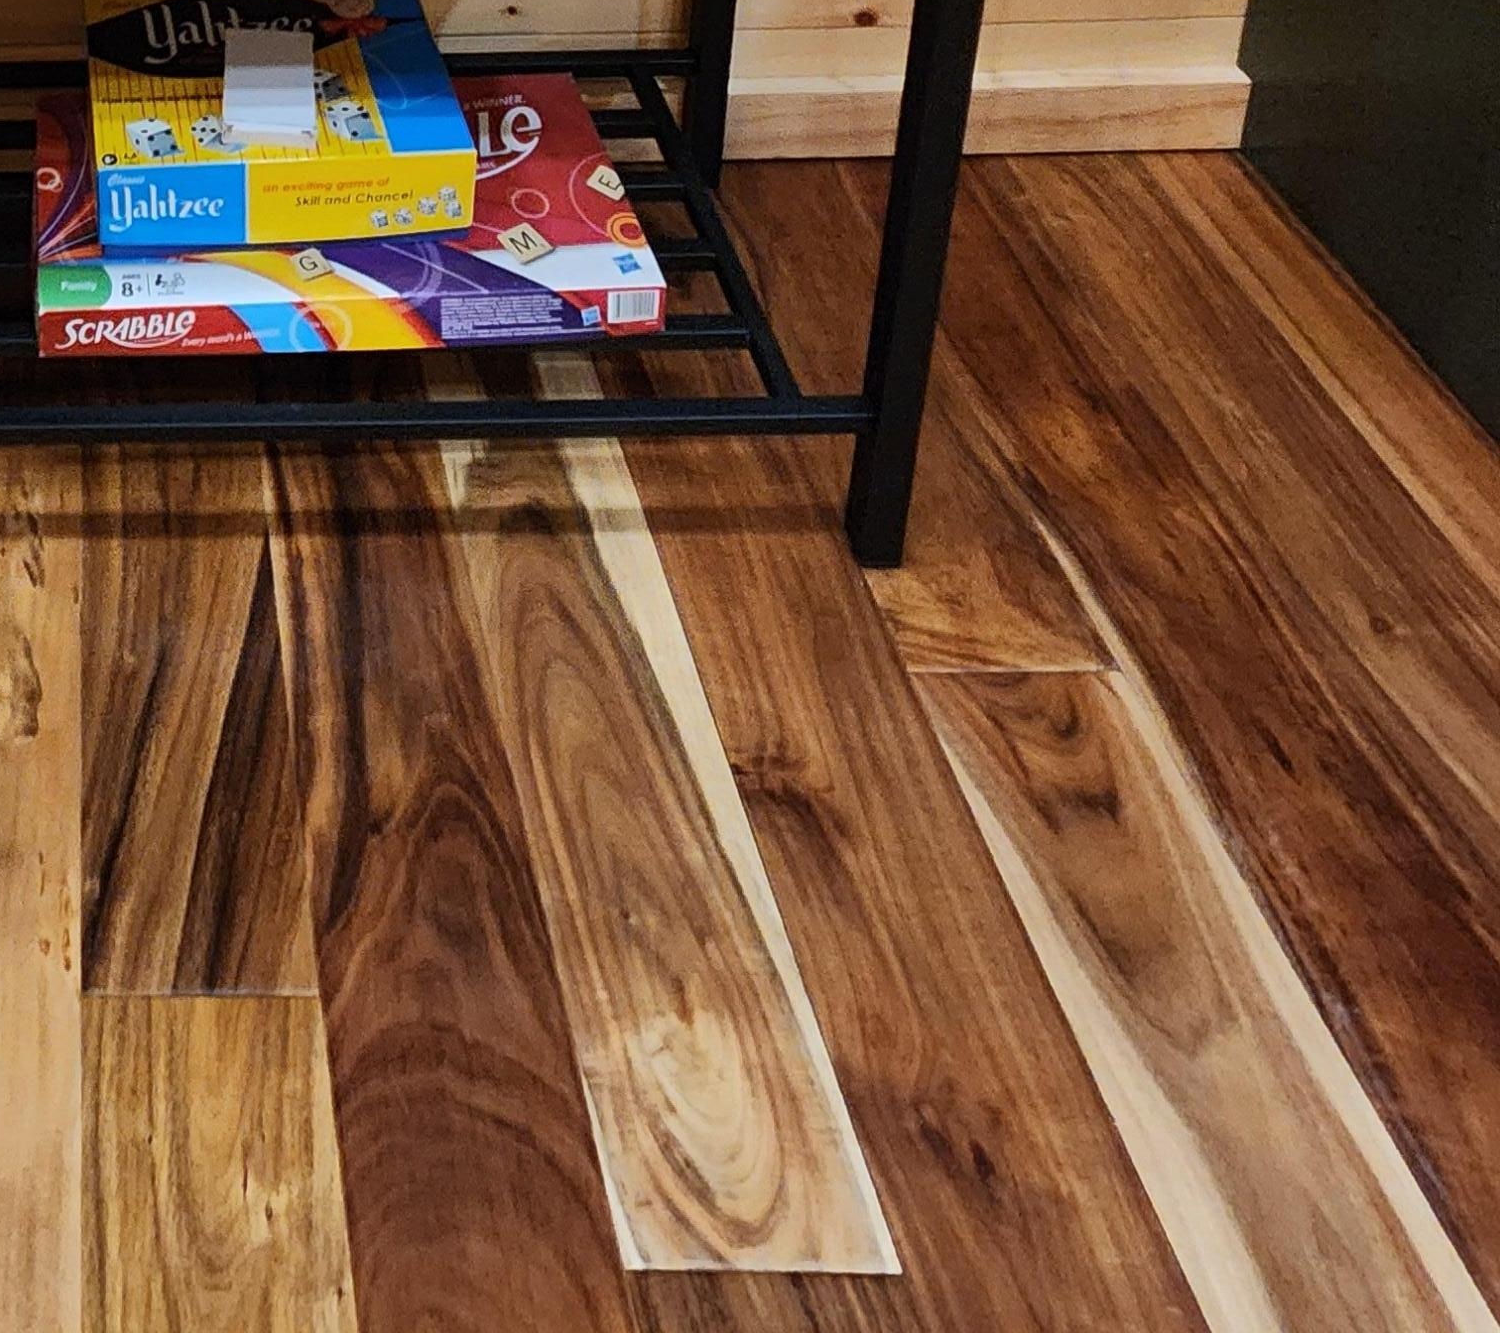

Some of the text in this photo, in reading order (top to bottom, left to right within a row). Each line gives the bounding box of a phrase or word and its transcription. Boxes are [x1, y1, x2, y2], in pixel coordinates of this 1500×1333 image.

[336, 180, 373, 191] game
[295, 189, 413, 207] Skill and Chance!
[108, 183, 225, 233] Yahtzee
[508, 230, 539, 255] M
[299, 255, 319, 272] G
[60, 279, 97, 292] Family
[121, 282, 142, 297] 8+
